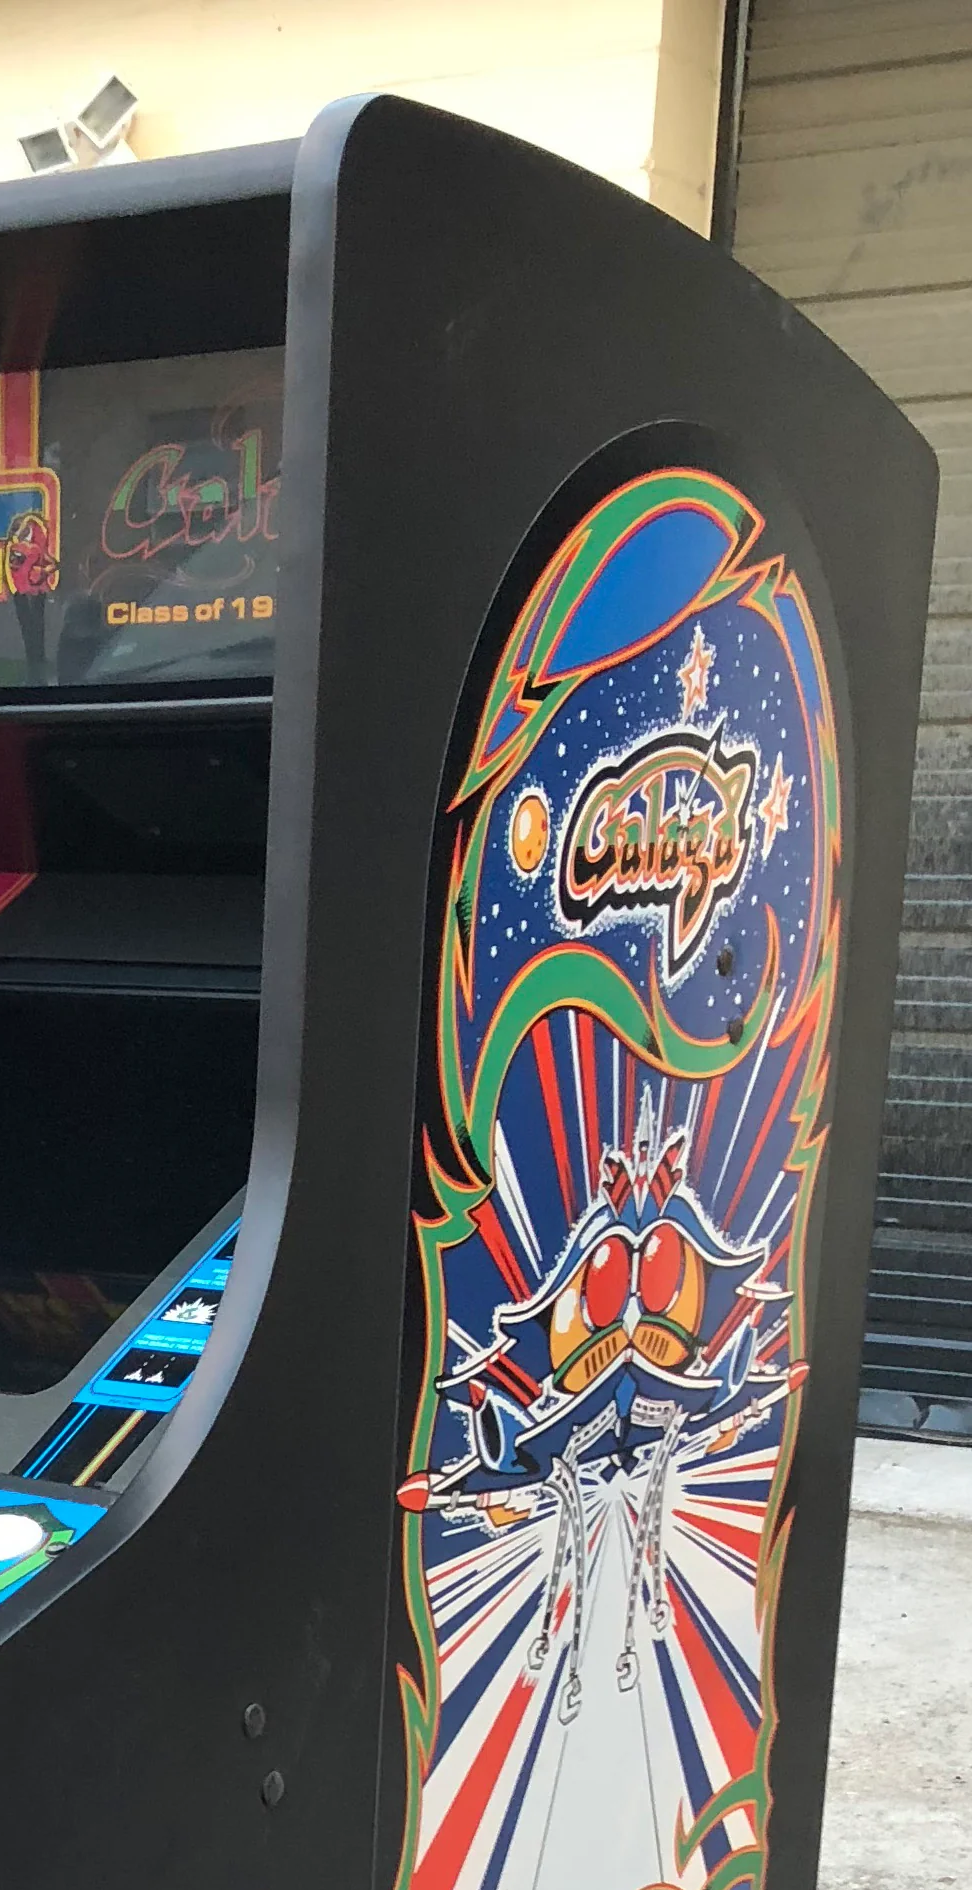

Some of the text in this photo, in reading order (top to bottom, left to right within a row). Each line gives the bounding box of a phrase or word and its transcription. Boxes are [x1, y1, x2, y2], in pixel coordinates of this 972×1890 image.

[107, 595, 276, 625] Class of 19
[564, 748, 756, 960] Galaga
